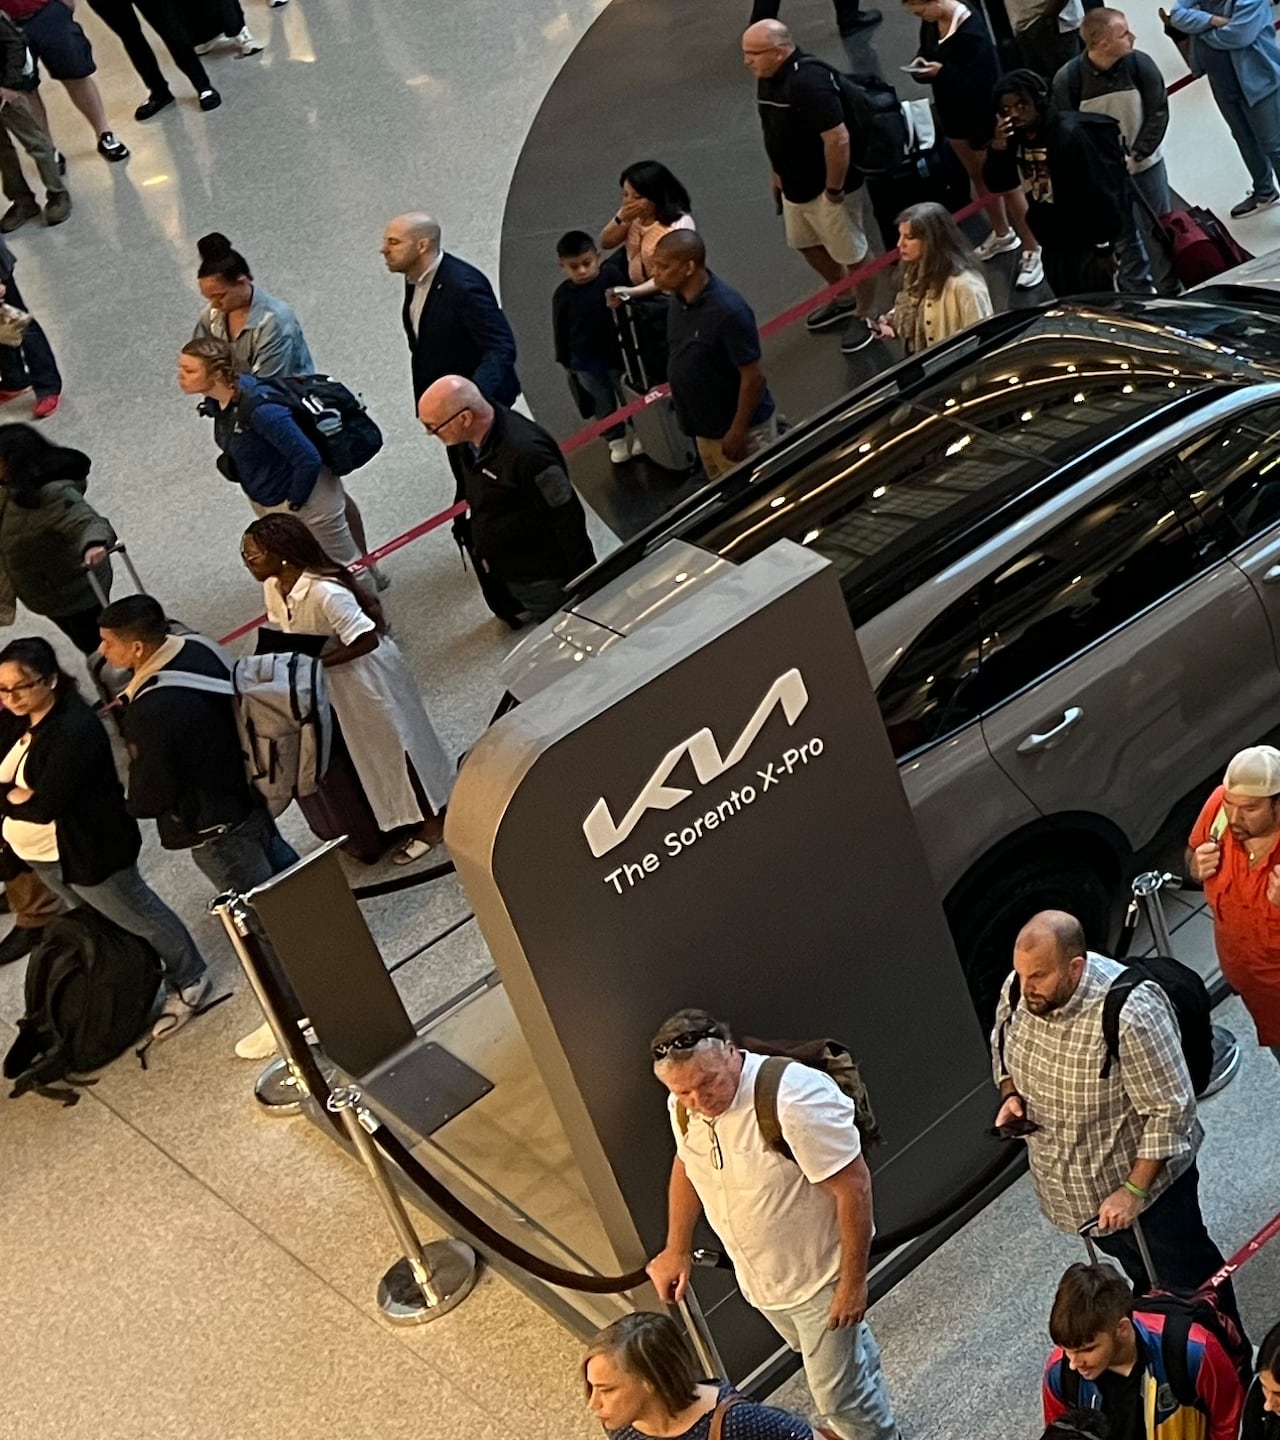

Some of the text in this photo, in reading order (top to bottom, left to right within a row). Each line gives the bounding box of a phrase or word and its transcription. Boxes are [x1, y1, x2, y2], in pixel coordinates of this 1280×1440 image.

[603, 737, 825, 895] The Sorento X-Pro
[1210, 1263, 1238, 1287] ATL
